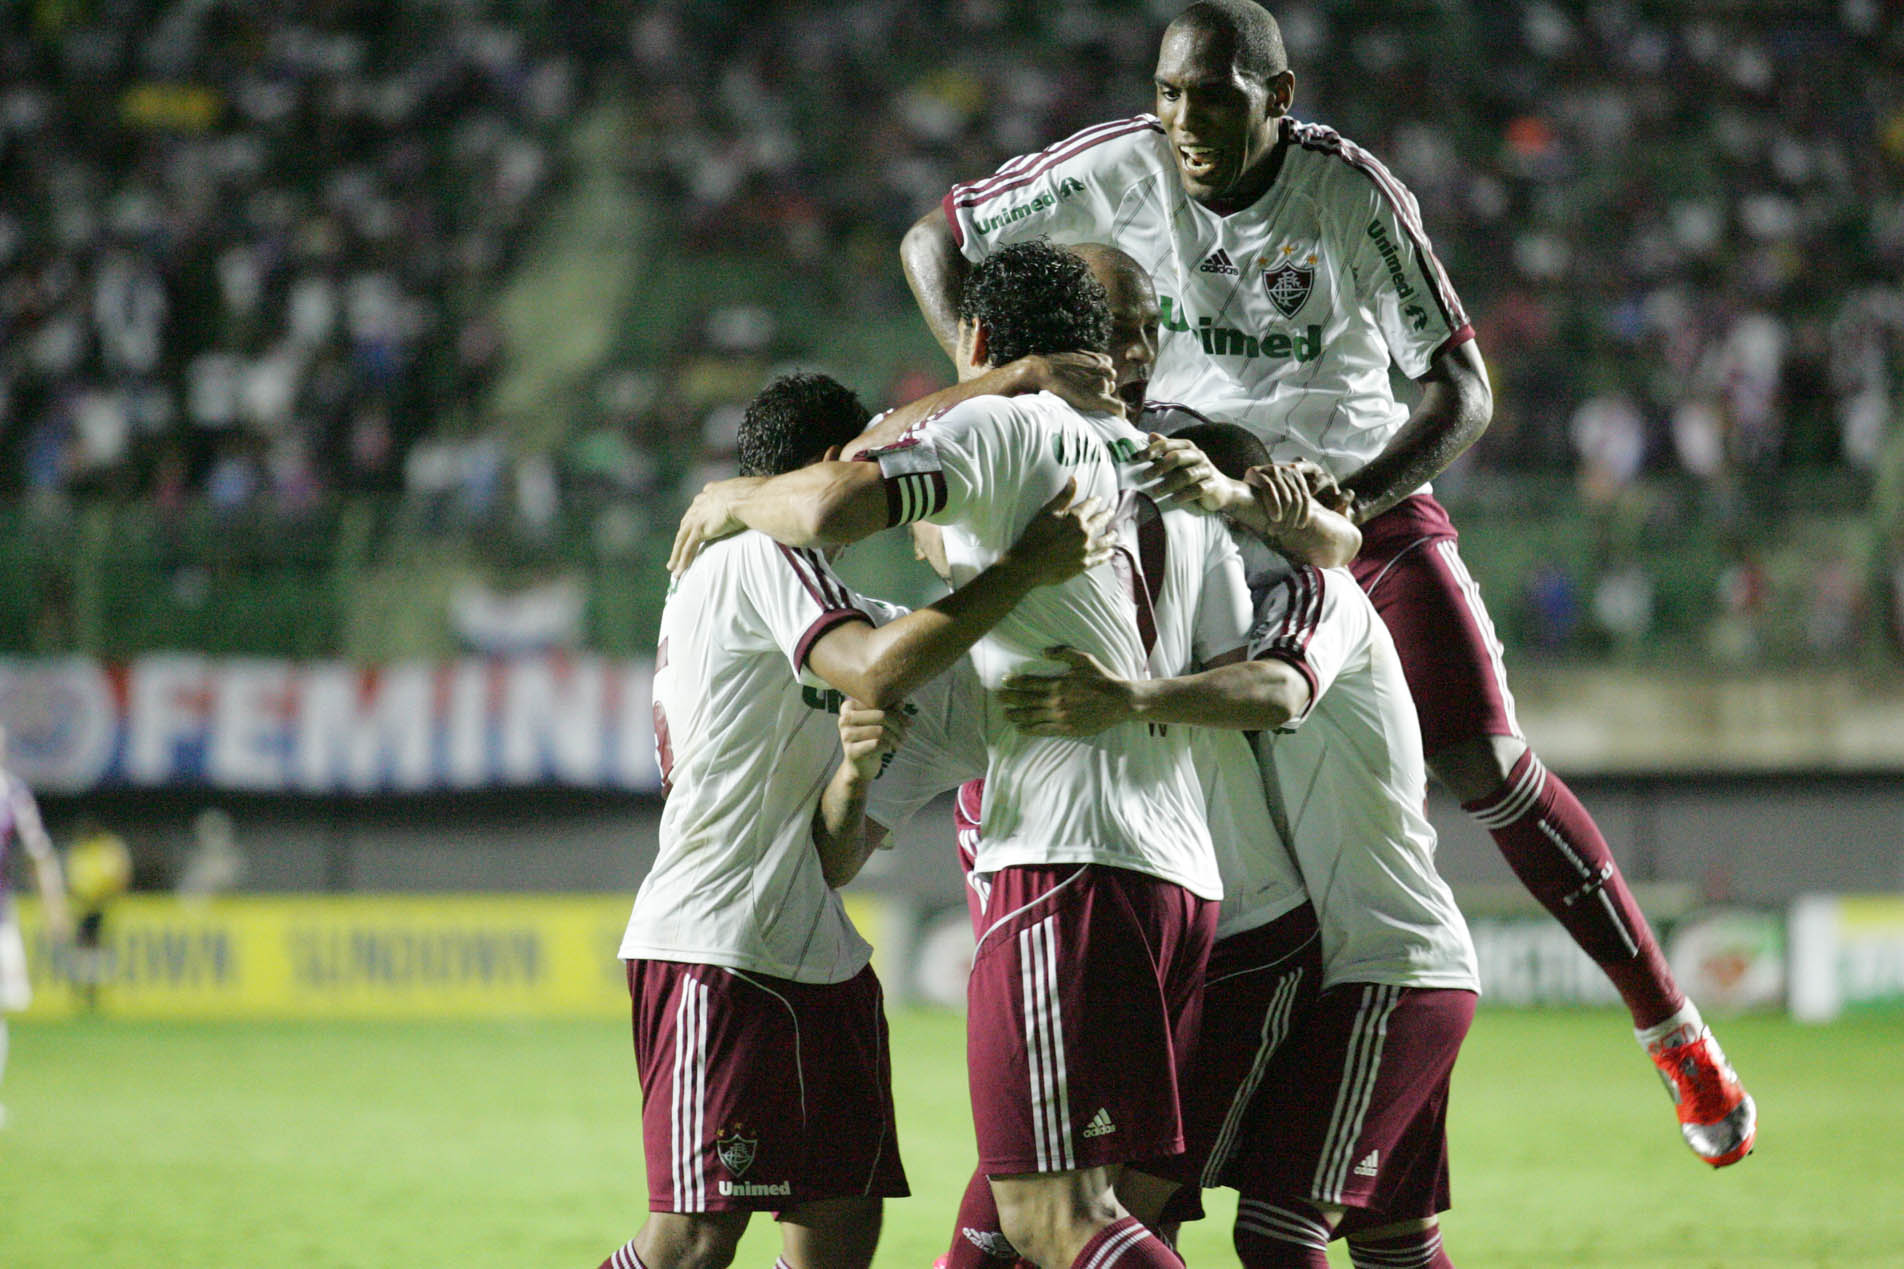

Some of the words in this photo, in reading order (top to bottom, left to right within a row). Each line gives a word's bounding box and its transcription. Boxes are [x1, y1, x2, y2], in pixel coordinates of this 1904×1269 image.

[973, 188, 1057, 235] Unimed
[1200, 264, 1239, 276] adidas
[1367, 219, 1415, 299] Unimed
[1159, 295, 1322, 362] Uimed
[718, 1181, 791, 1197] Unimed
